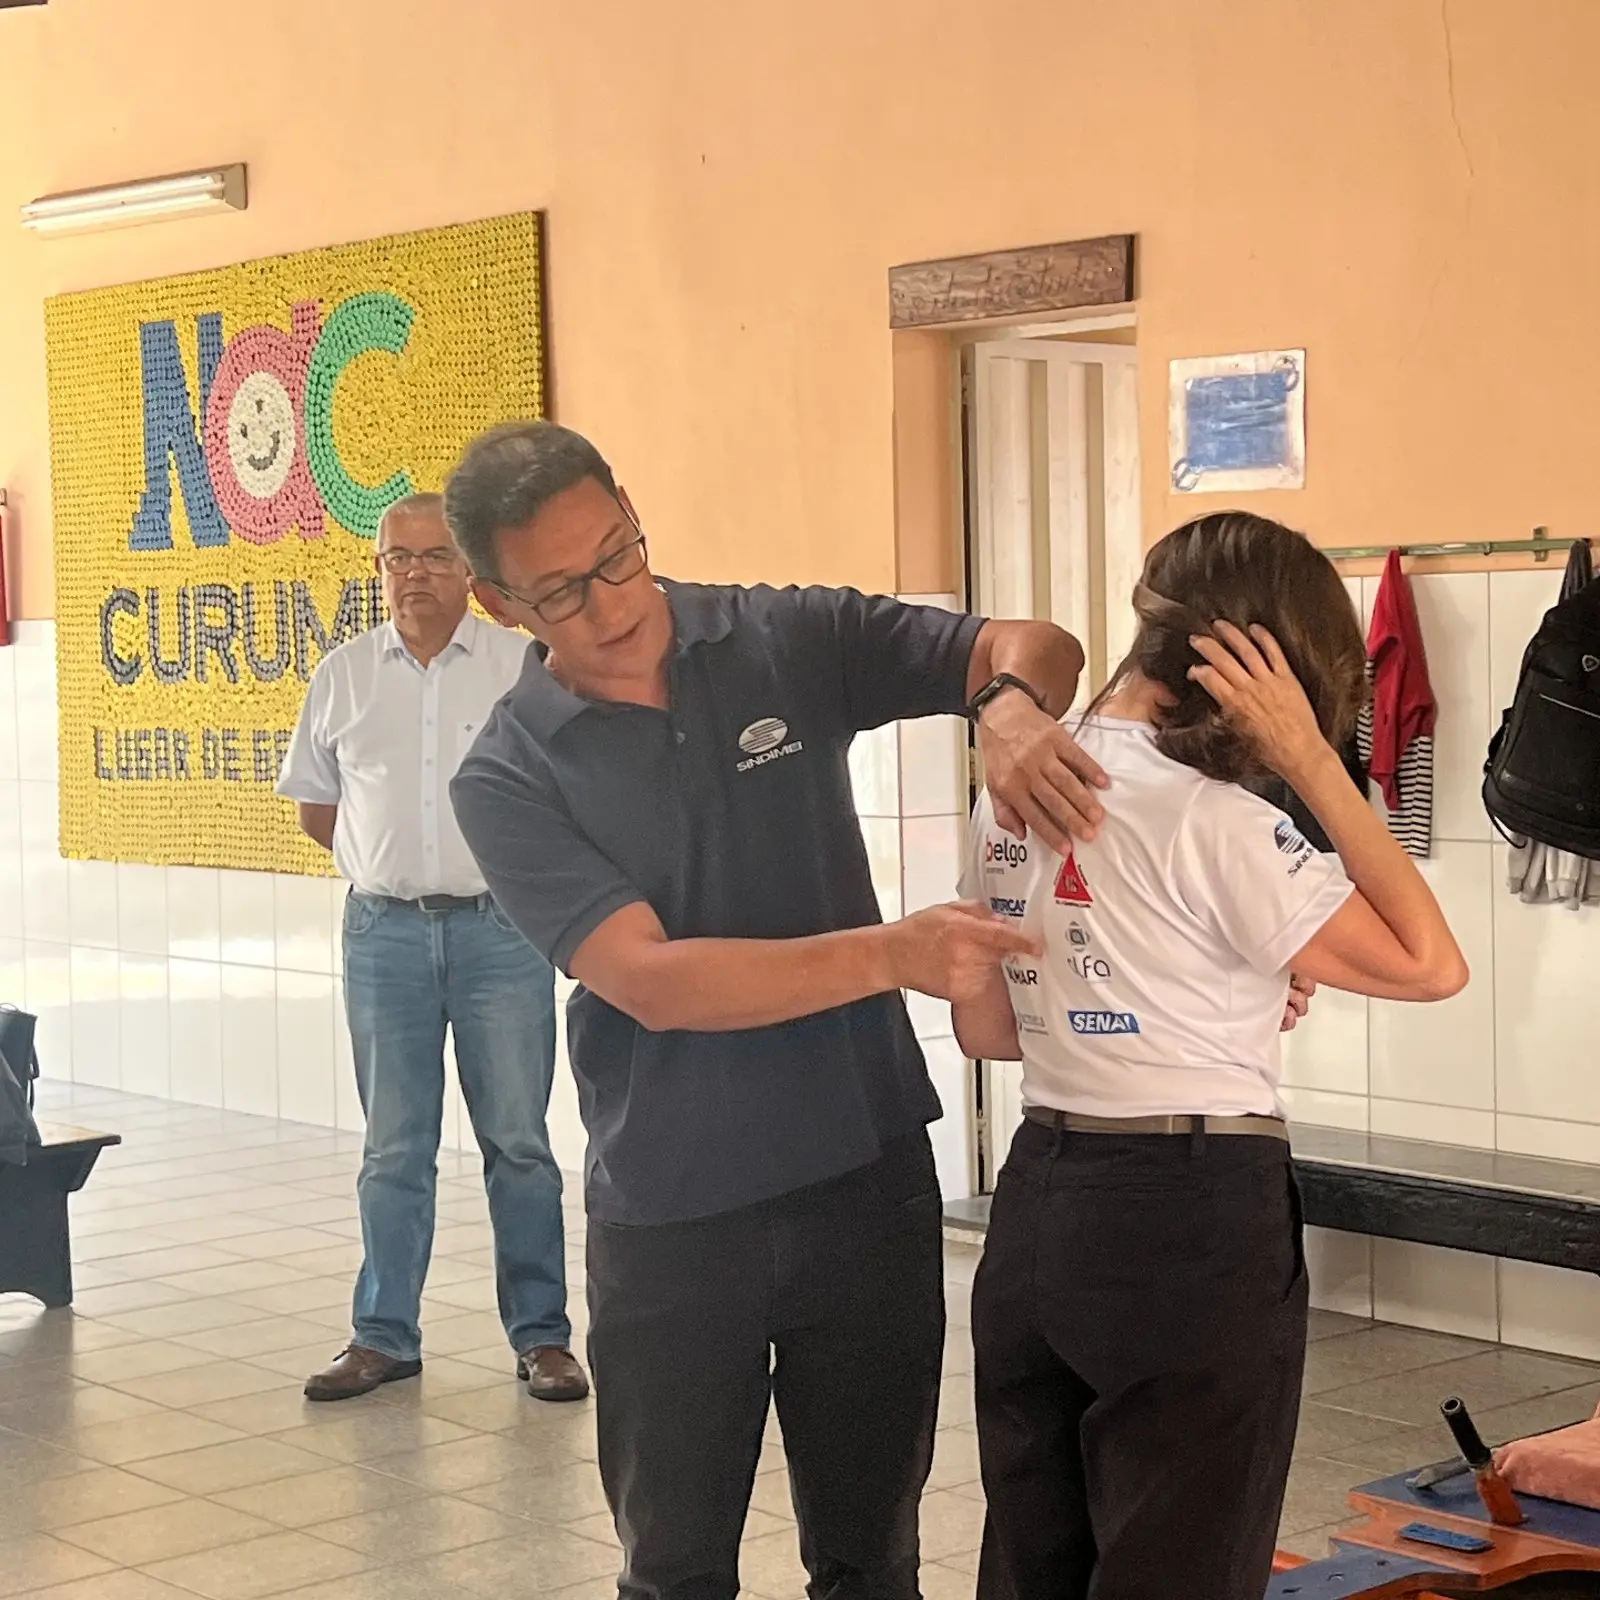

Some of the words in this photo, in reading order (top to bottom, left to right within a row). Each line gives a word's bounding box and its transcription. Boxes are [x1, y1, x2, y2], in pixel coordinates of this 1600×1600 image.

[202, 727, 243, 782] DE
[986, 834, 1028, 868] belgo
[1073, 1013, 1132, 1032] SENAI
